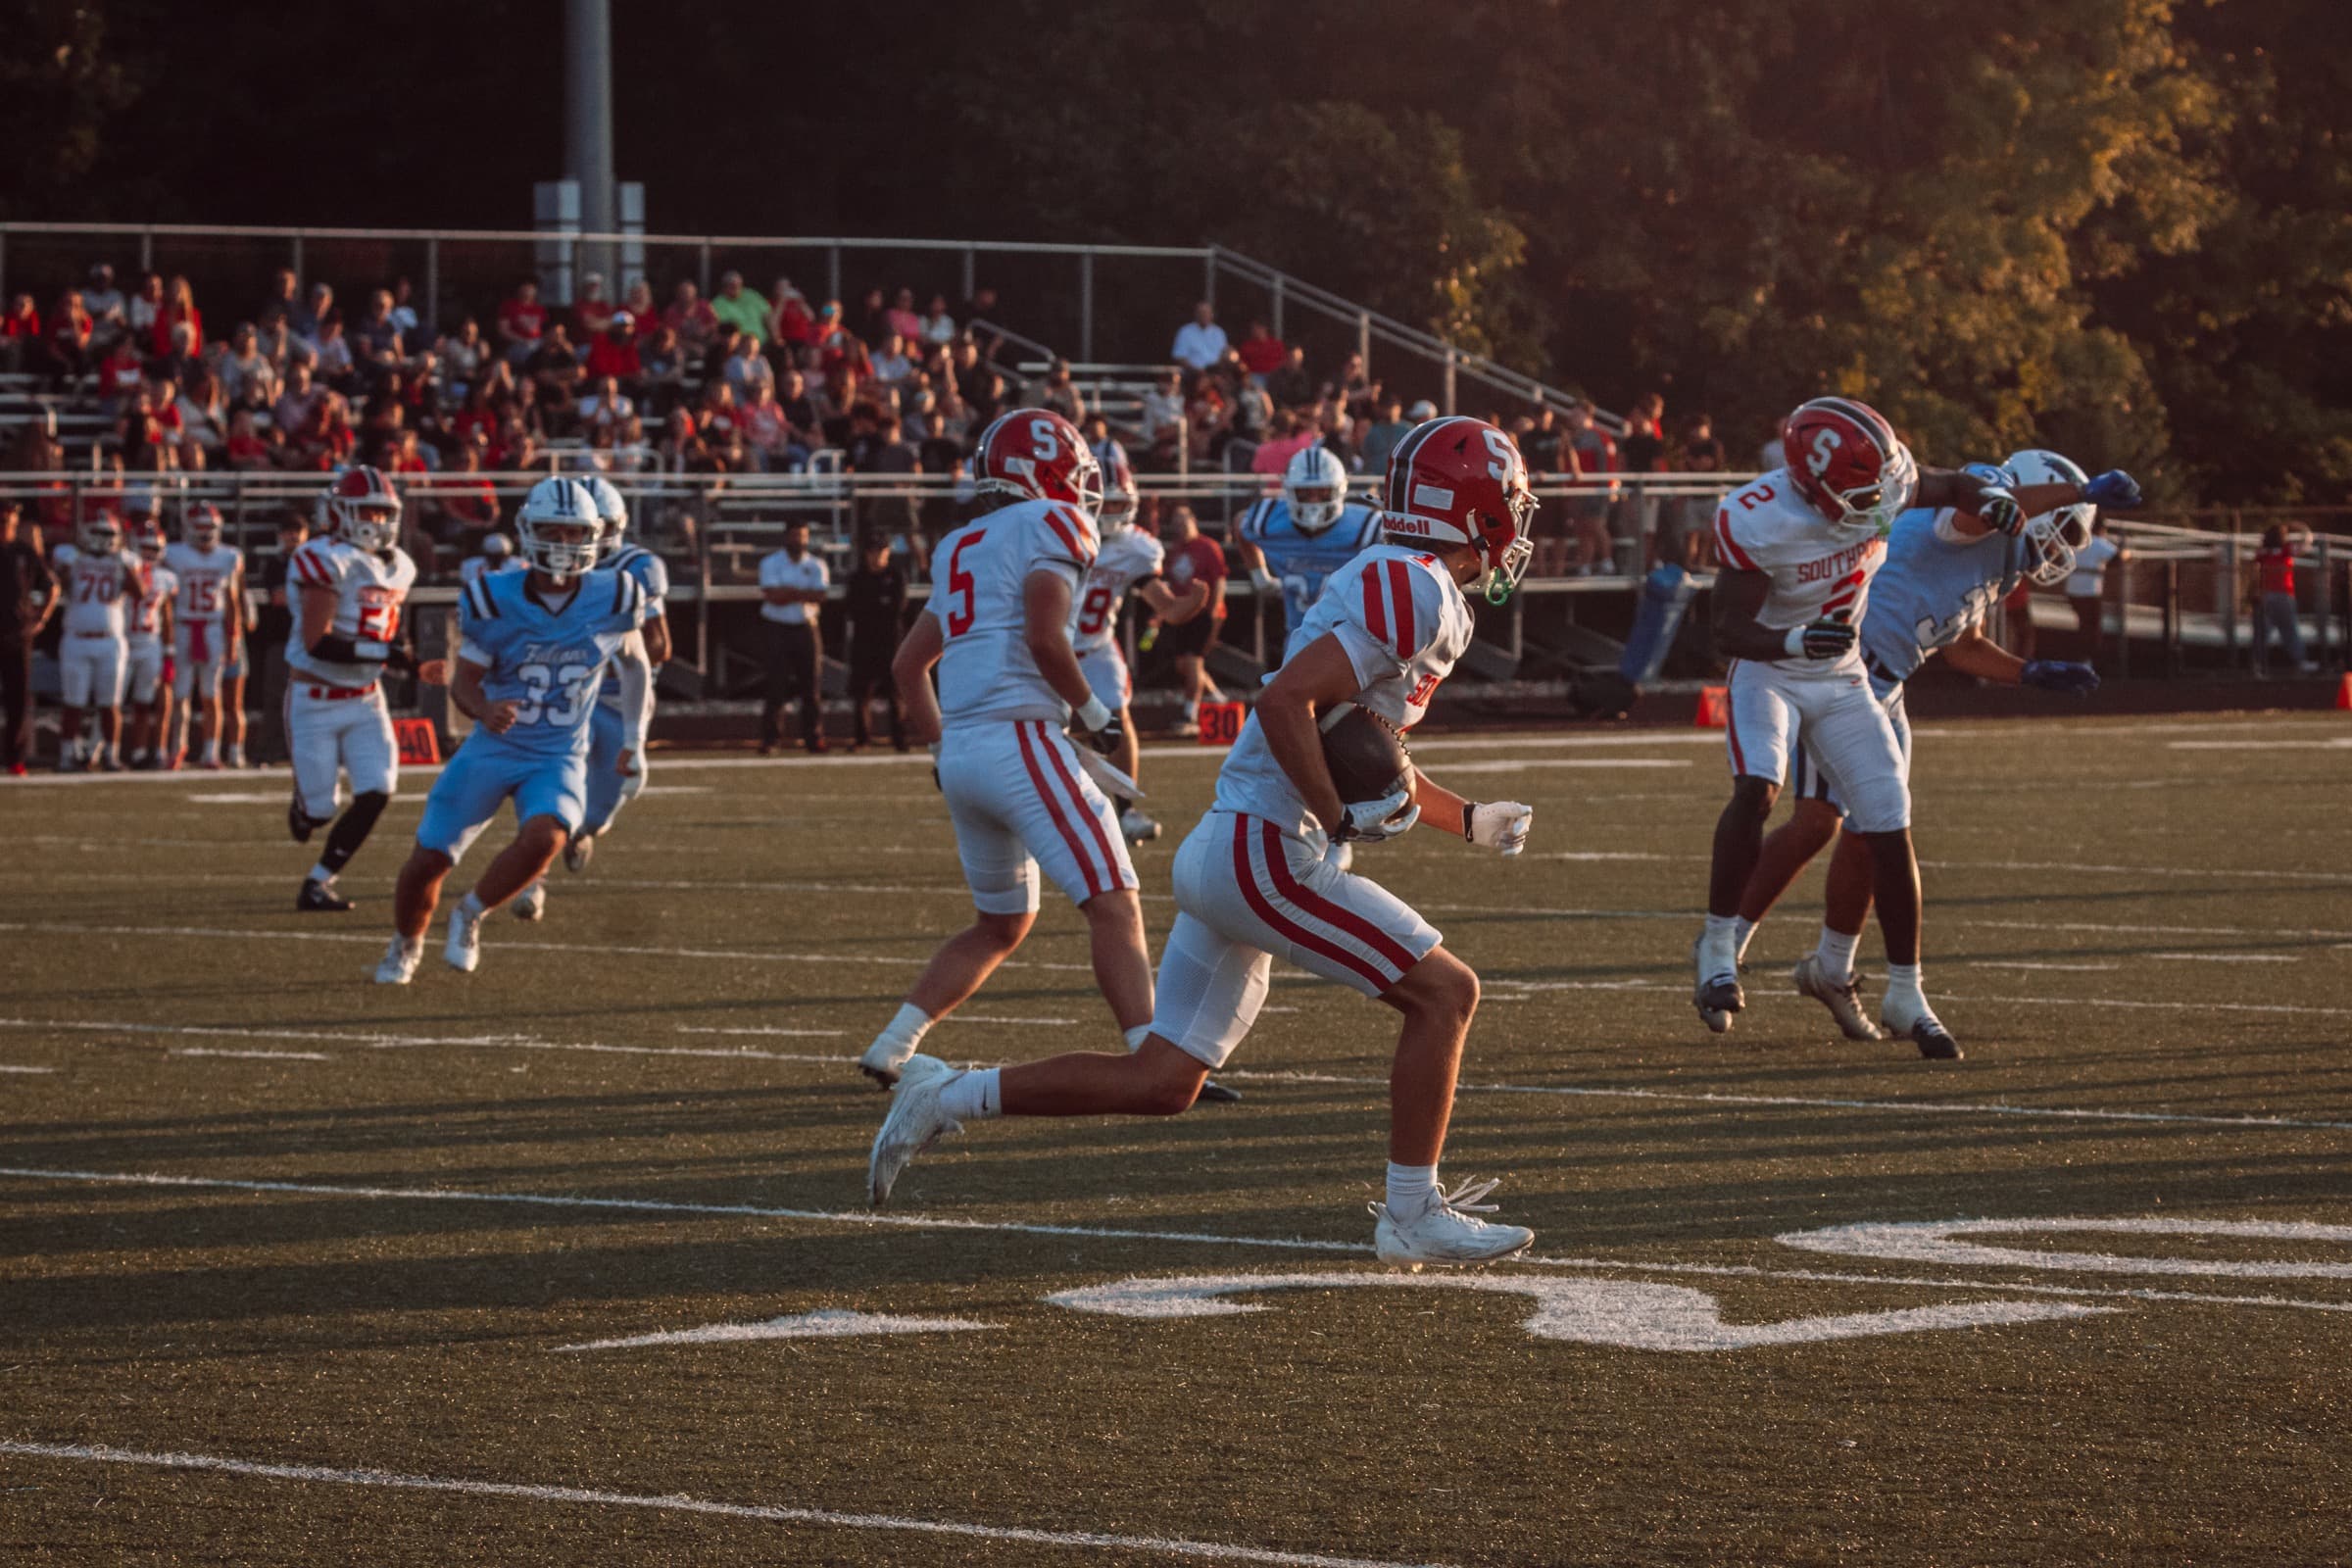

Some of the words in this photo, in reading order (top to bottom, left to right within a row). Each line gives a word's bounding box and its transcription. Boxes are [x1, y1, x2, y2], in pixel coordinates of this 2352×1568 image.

[1031, 418, 1058, 462] S
[1482, 429, 1514, 481] S
[1806, 428, 1841, 476] S
[1738, 484, 1776, 511] 2
[78, 571, 116, 604] 70
[189, 578, 217, 612] 15
[948, 528, 987, 637] 5
[516, 664, 590, 726] 33
[398, 725, 431, 758] 40
[1204, 708, 1239, 739] 30
